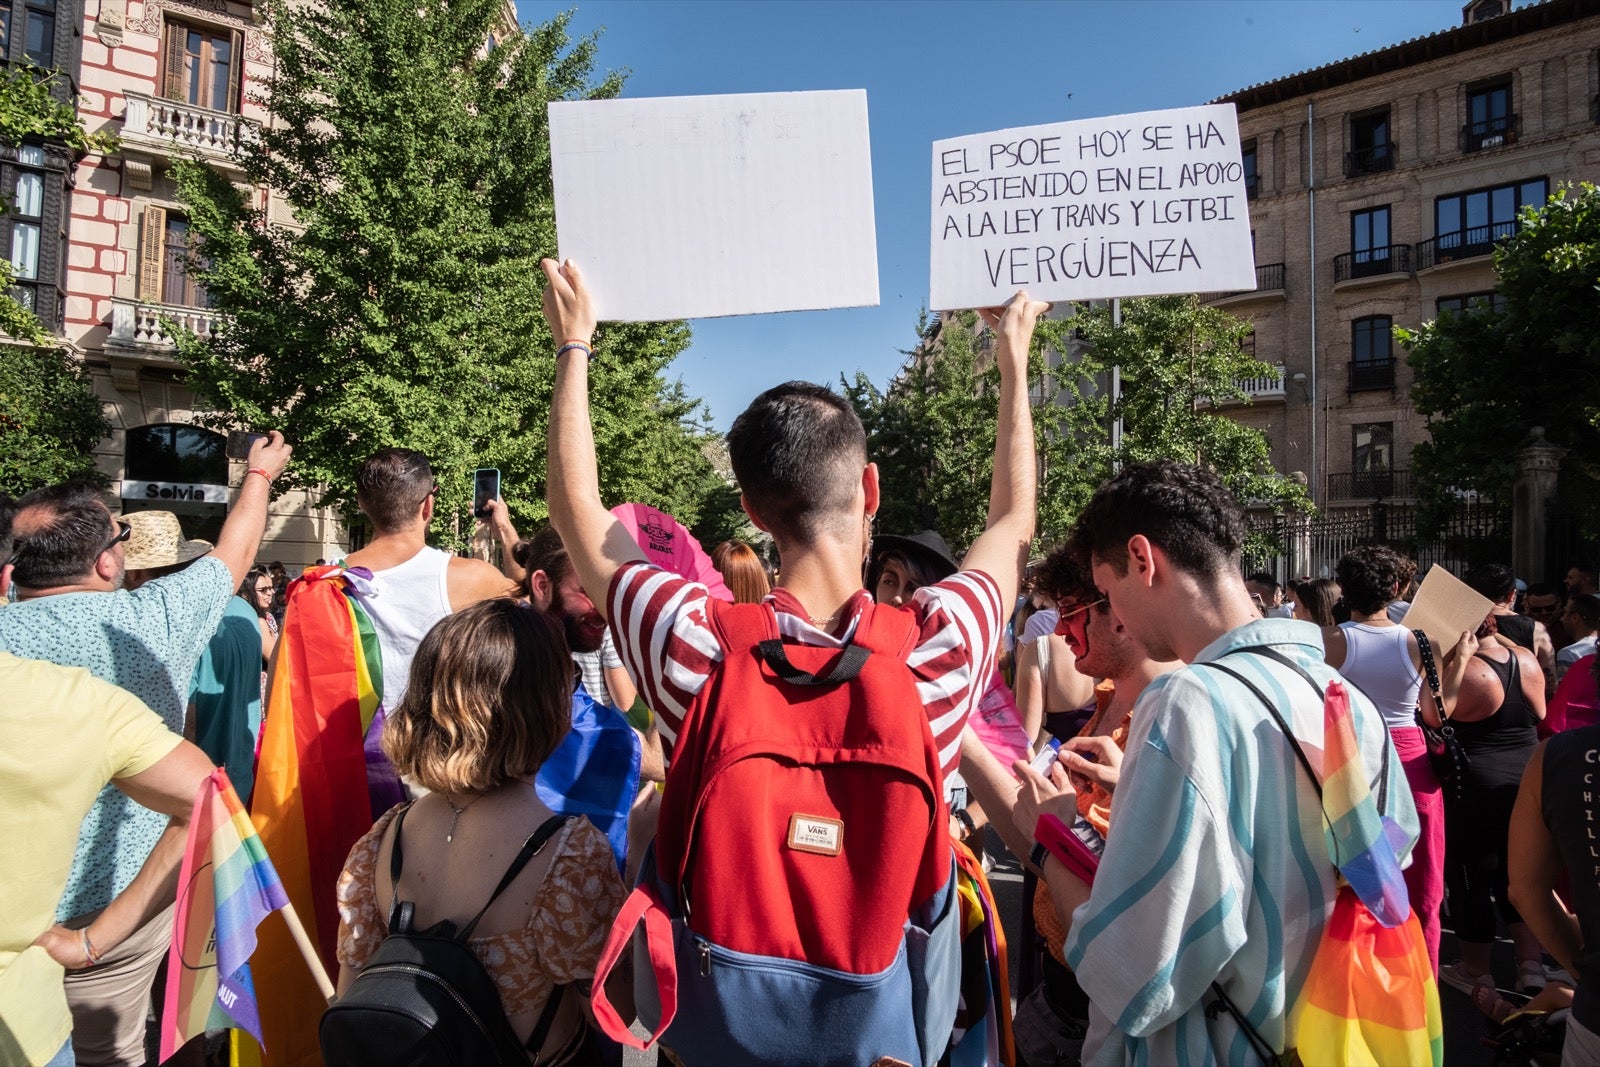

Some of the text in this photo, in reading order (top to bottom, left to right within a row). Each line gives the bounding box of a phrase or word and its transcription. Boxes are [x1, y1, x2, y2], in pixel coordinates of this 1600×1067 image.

[941, 121, 1225, 176] EL PSOE HOY SE HA
[940, 162, 1242, 207] ABSTENIDO EN EL APOYO
[943, 196, 1235, 240] A LA LEY TRANS Y LGTBI
[984, 237, 1202, 287] VERGÜENZA
[145, 484, 205, 500] Solvia
[807, 825, 828, 836] VANS
